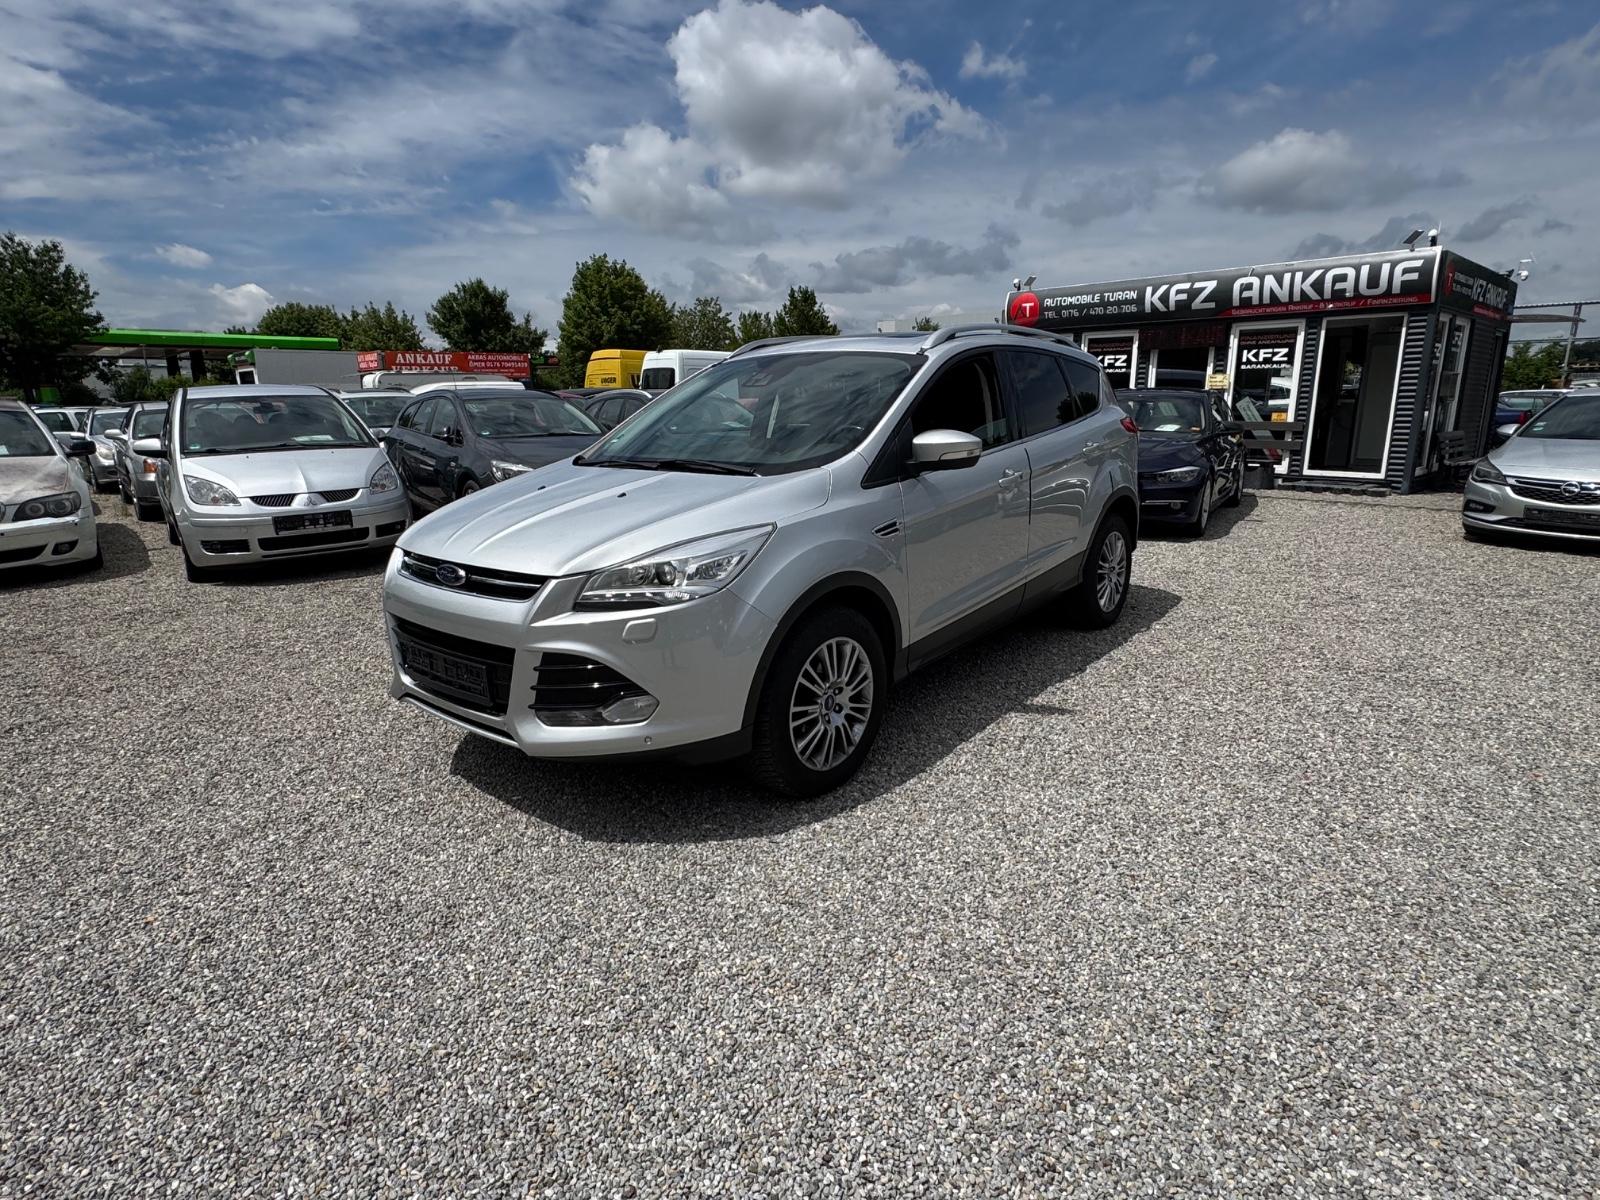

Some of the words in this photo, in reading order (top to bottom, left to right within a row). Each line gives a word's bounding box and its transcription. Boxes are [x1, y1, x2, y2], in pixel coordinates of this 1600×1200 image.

[1145, 280, 1218, 313] KFZ
[1232, 259, 1424, 306] ANKAUF
[1044, 294, 1100, 307] AUTOMOBILE
[1104, 290, 1138, 302] TURAN
[1061, 309, 1079, 318] 0176
[1089, 307, 1103, 315] 470
[1106, 305, 1118, 314] 20
[1120, 304, 1138, 313] 706
[395, 353, 452, 364] ANKAUF
[1242, 348, 1289, 362] KFZ
